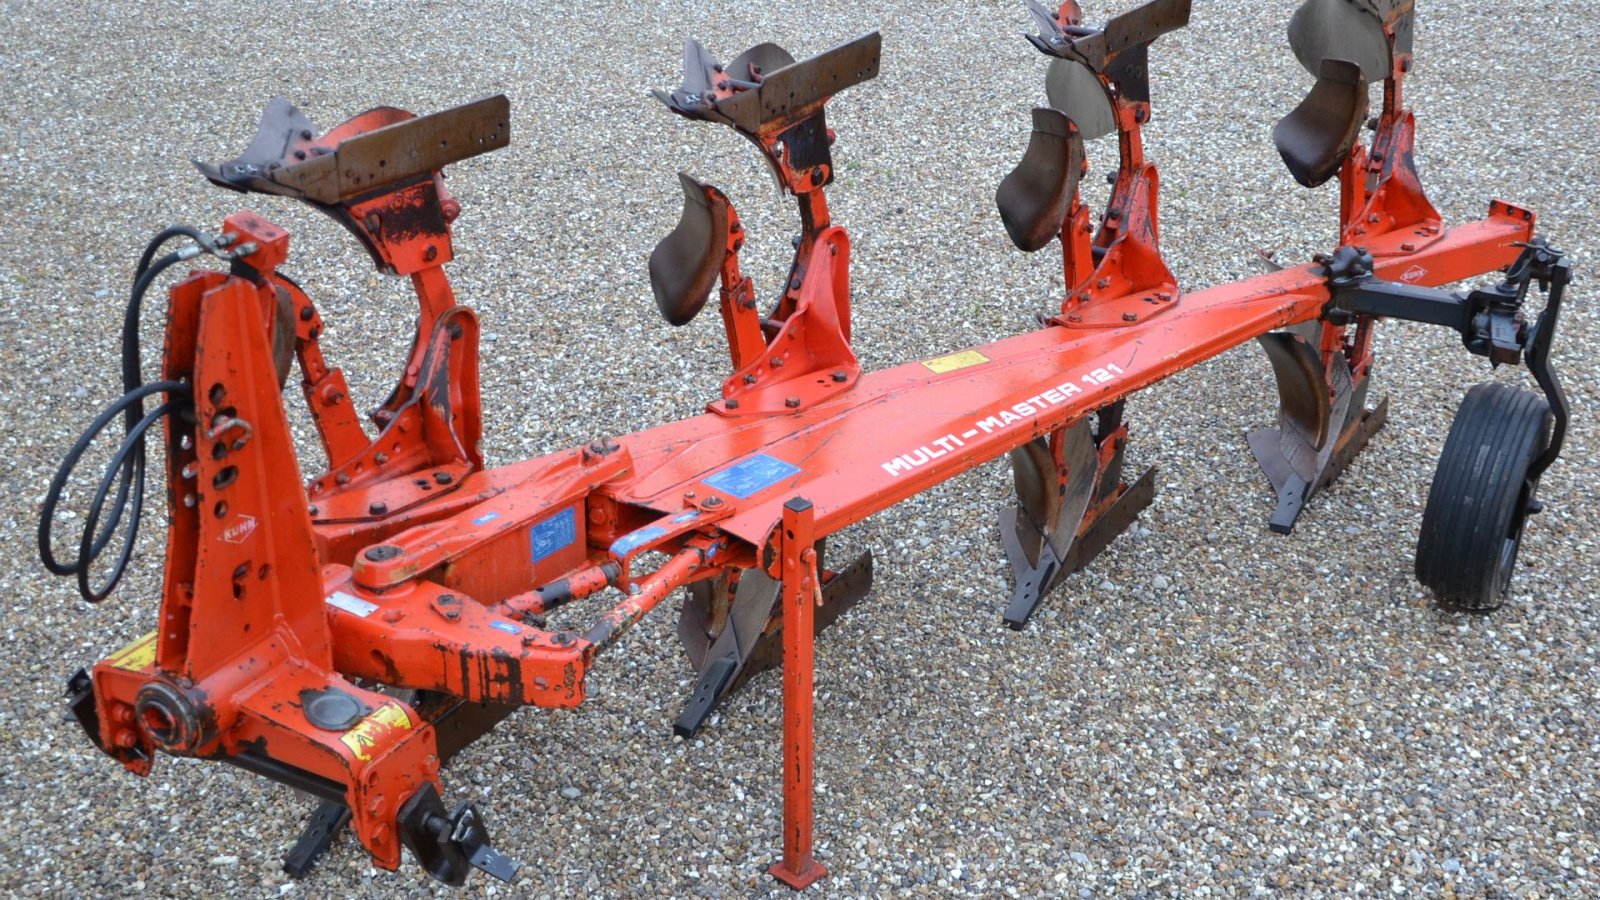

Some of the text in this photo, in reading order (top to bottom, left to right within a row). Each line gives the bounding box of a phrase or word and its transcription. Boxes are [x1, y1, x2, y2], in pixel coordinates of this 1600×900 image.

[881, 363, 1125, 477] MULTI-MASTER 121
[224, 518, 256, 540] KUHN
